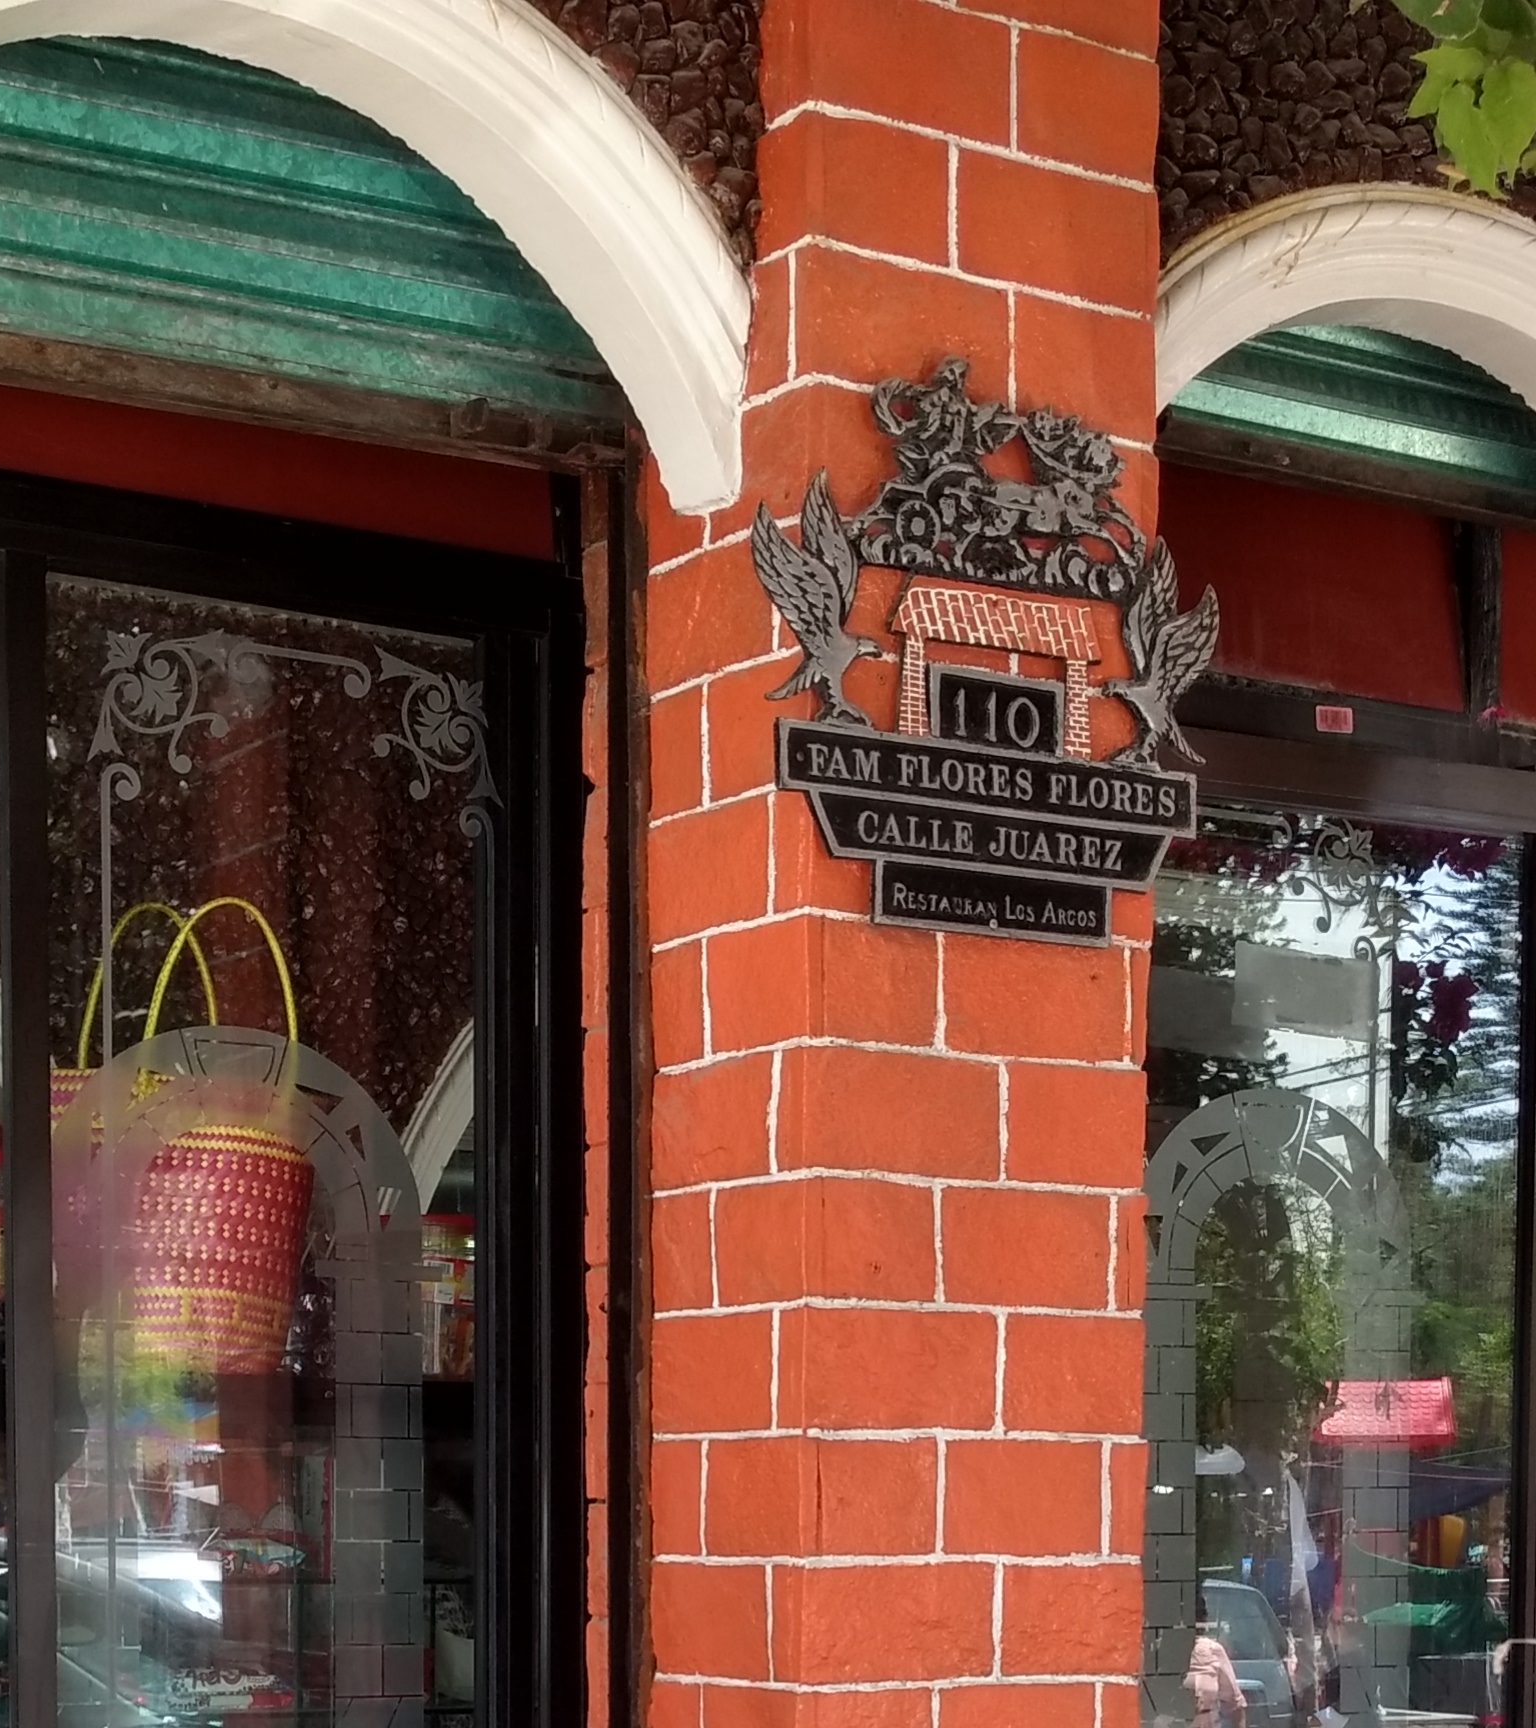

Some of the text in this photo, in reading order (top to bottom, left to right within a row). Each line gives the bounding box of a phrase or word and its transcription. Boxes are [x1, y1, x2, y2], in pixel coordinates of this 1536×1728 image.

[953, 687, 1040, 748] 110
[807, 743, 1176, 817] FAM FLORES FLORES
[857, 810, 1122, 871] CALLE JUAREZ
